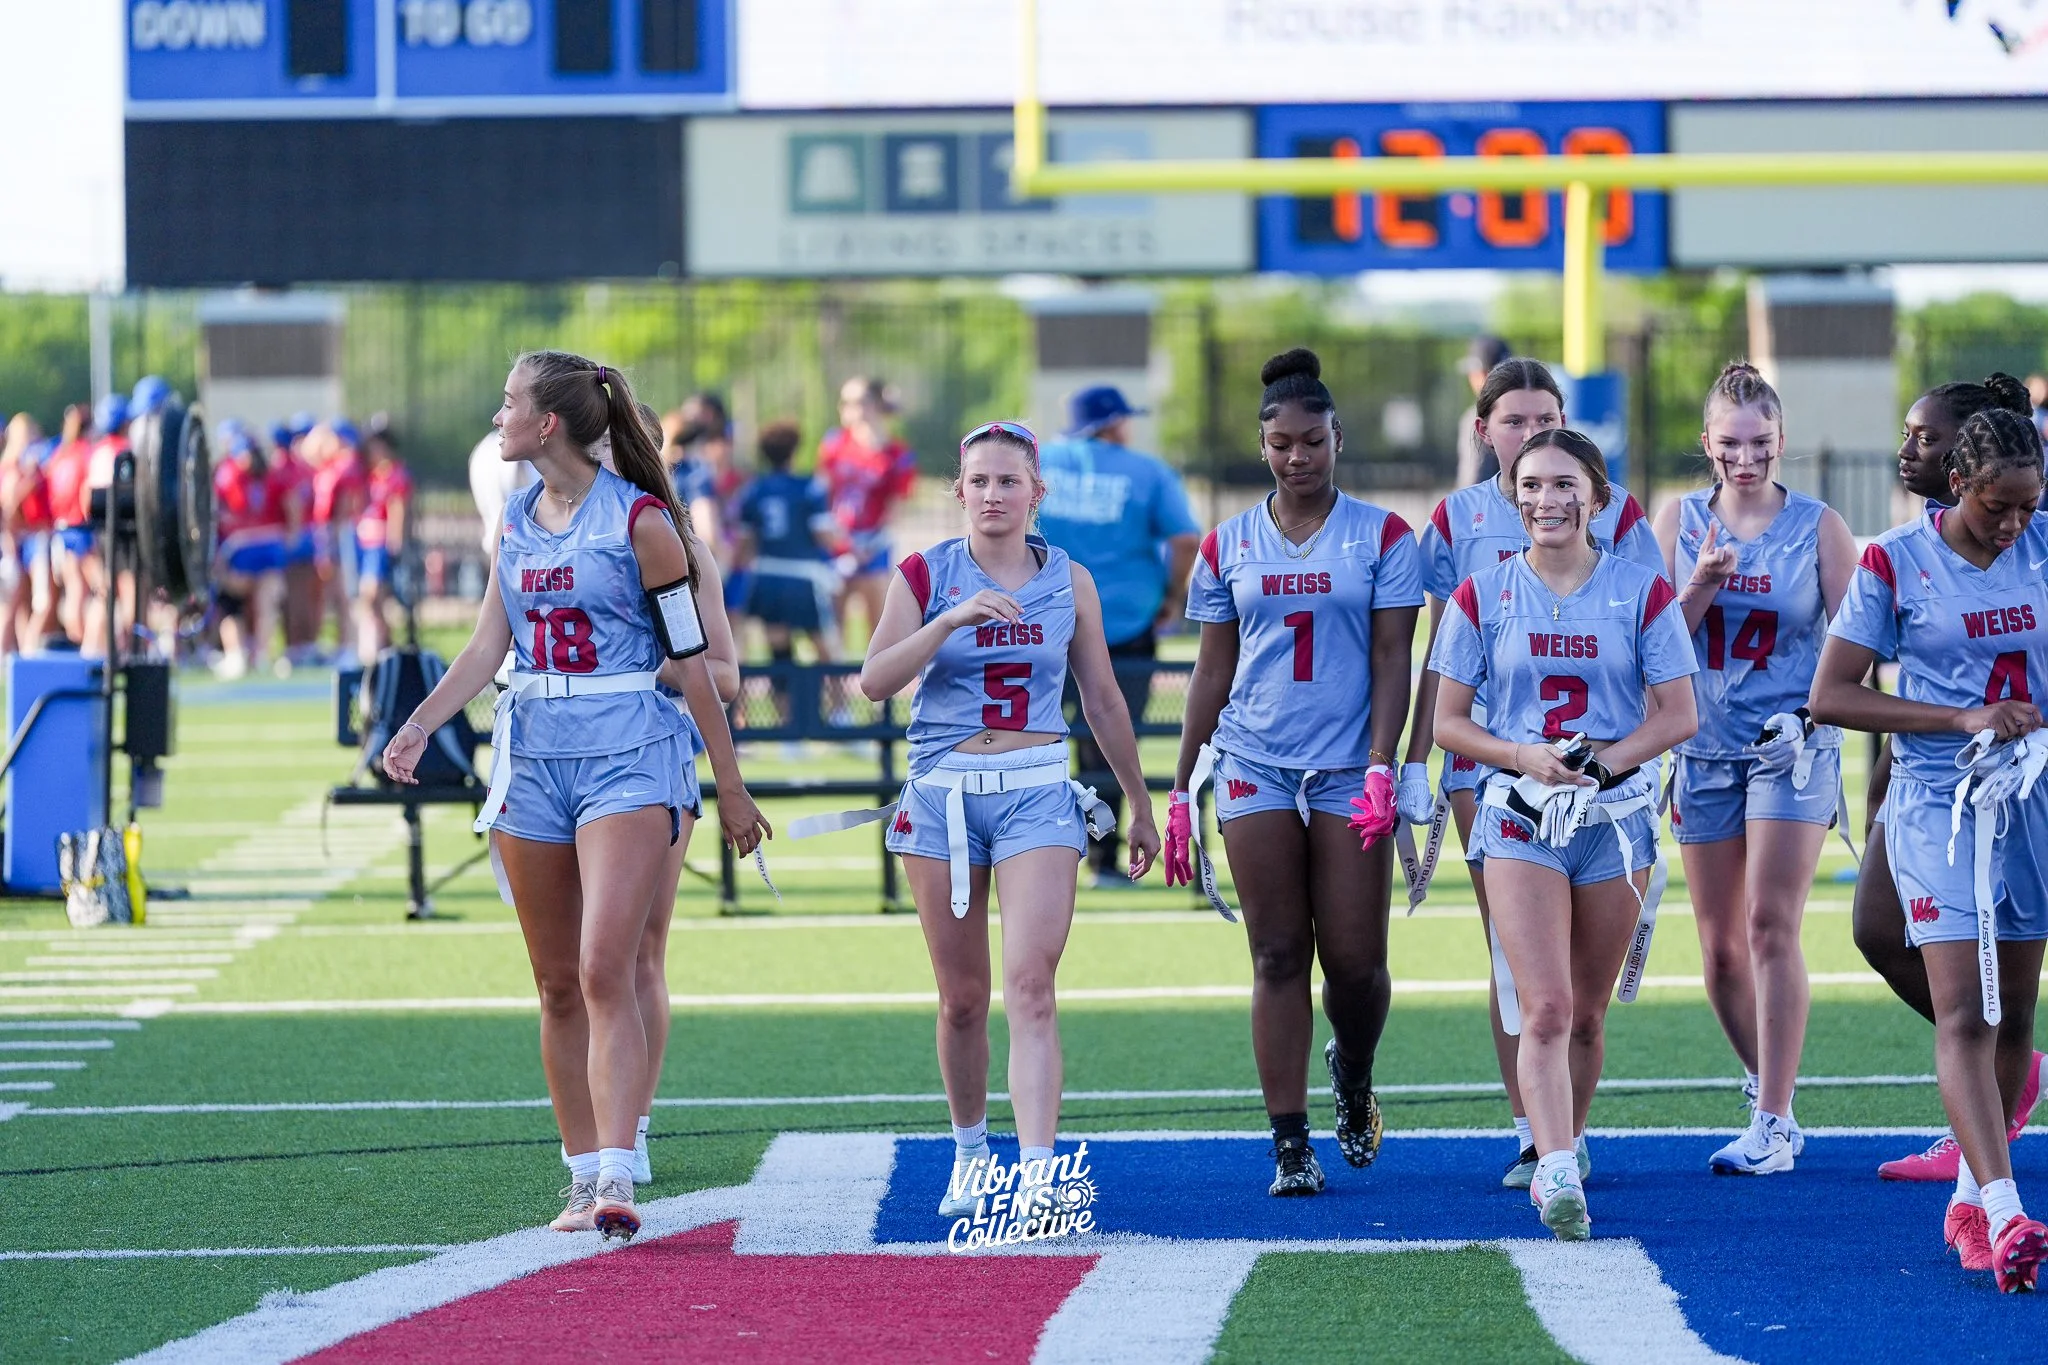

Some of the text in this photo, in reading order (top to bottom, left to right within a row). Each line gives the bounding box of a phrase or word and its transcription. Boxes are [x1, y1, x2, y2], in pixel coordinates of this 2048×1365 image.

[132, 0, 266, 49] DOWN
[402, 0, 532, 47] TO GO
[521, 566, 574, 592] WEISS
[1261, 572, 1332, 596] WEISS
[1720, 574, 1771, 593] EISS
[525, 607, 599, 673] 18
[976, 624, 1044, 648] WEISS
[1284, 611, 1314, 682] 1
[1528, 633, 1599, 659] WEISS
[1704, 604, 1779, 671] 14
[1961, 604, 2037, 639] WEISS
[982, 662, 1033, 731] 5
[1983, 650, 2032, 706] 4
[1540, 675, 1589, 740] 2
[1414, 813, 1444, 894] USA FOOTBALL
[1205, 876, 1230, 917] FOOTBALL
[1622, 929, 1648, 996] USA FOOTBALL
[1982, 920, 1996, 1015] USA FOOTBALL
